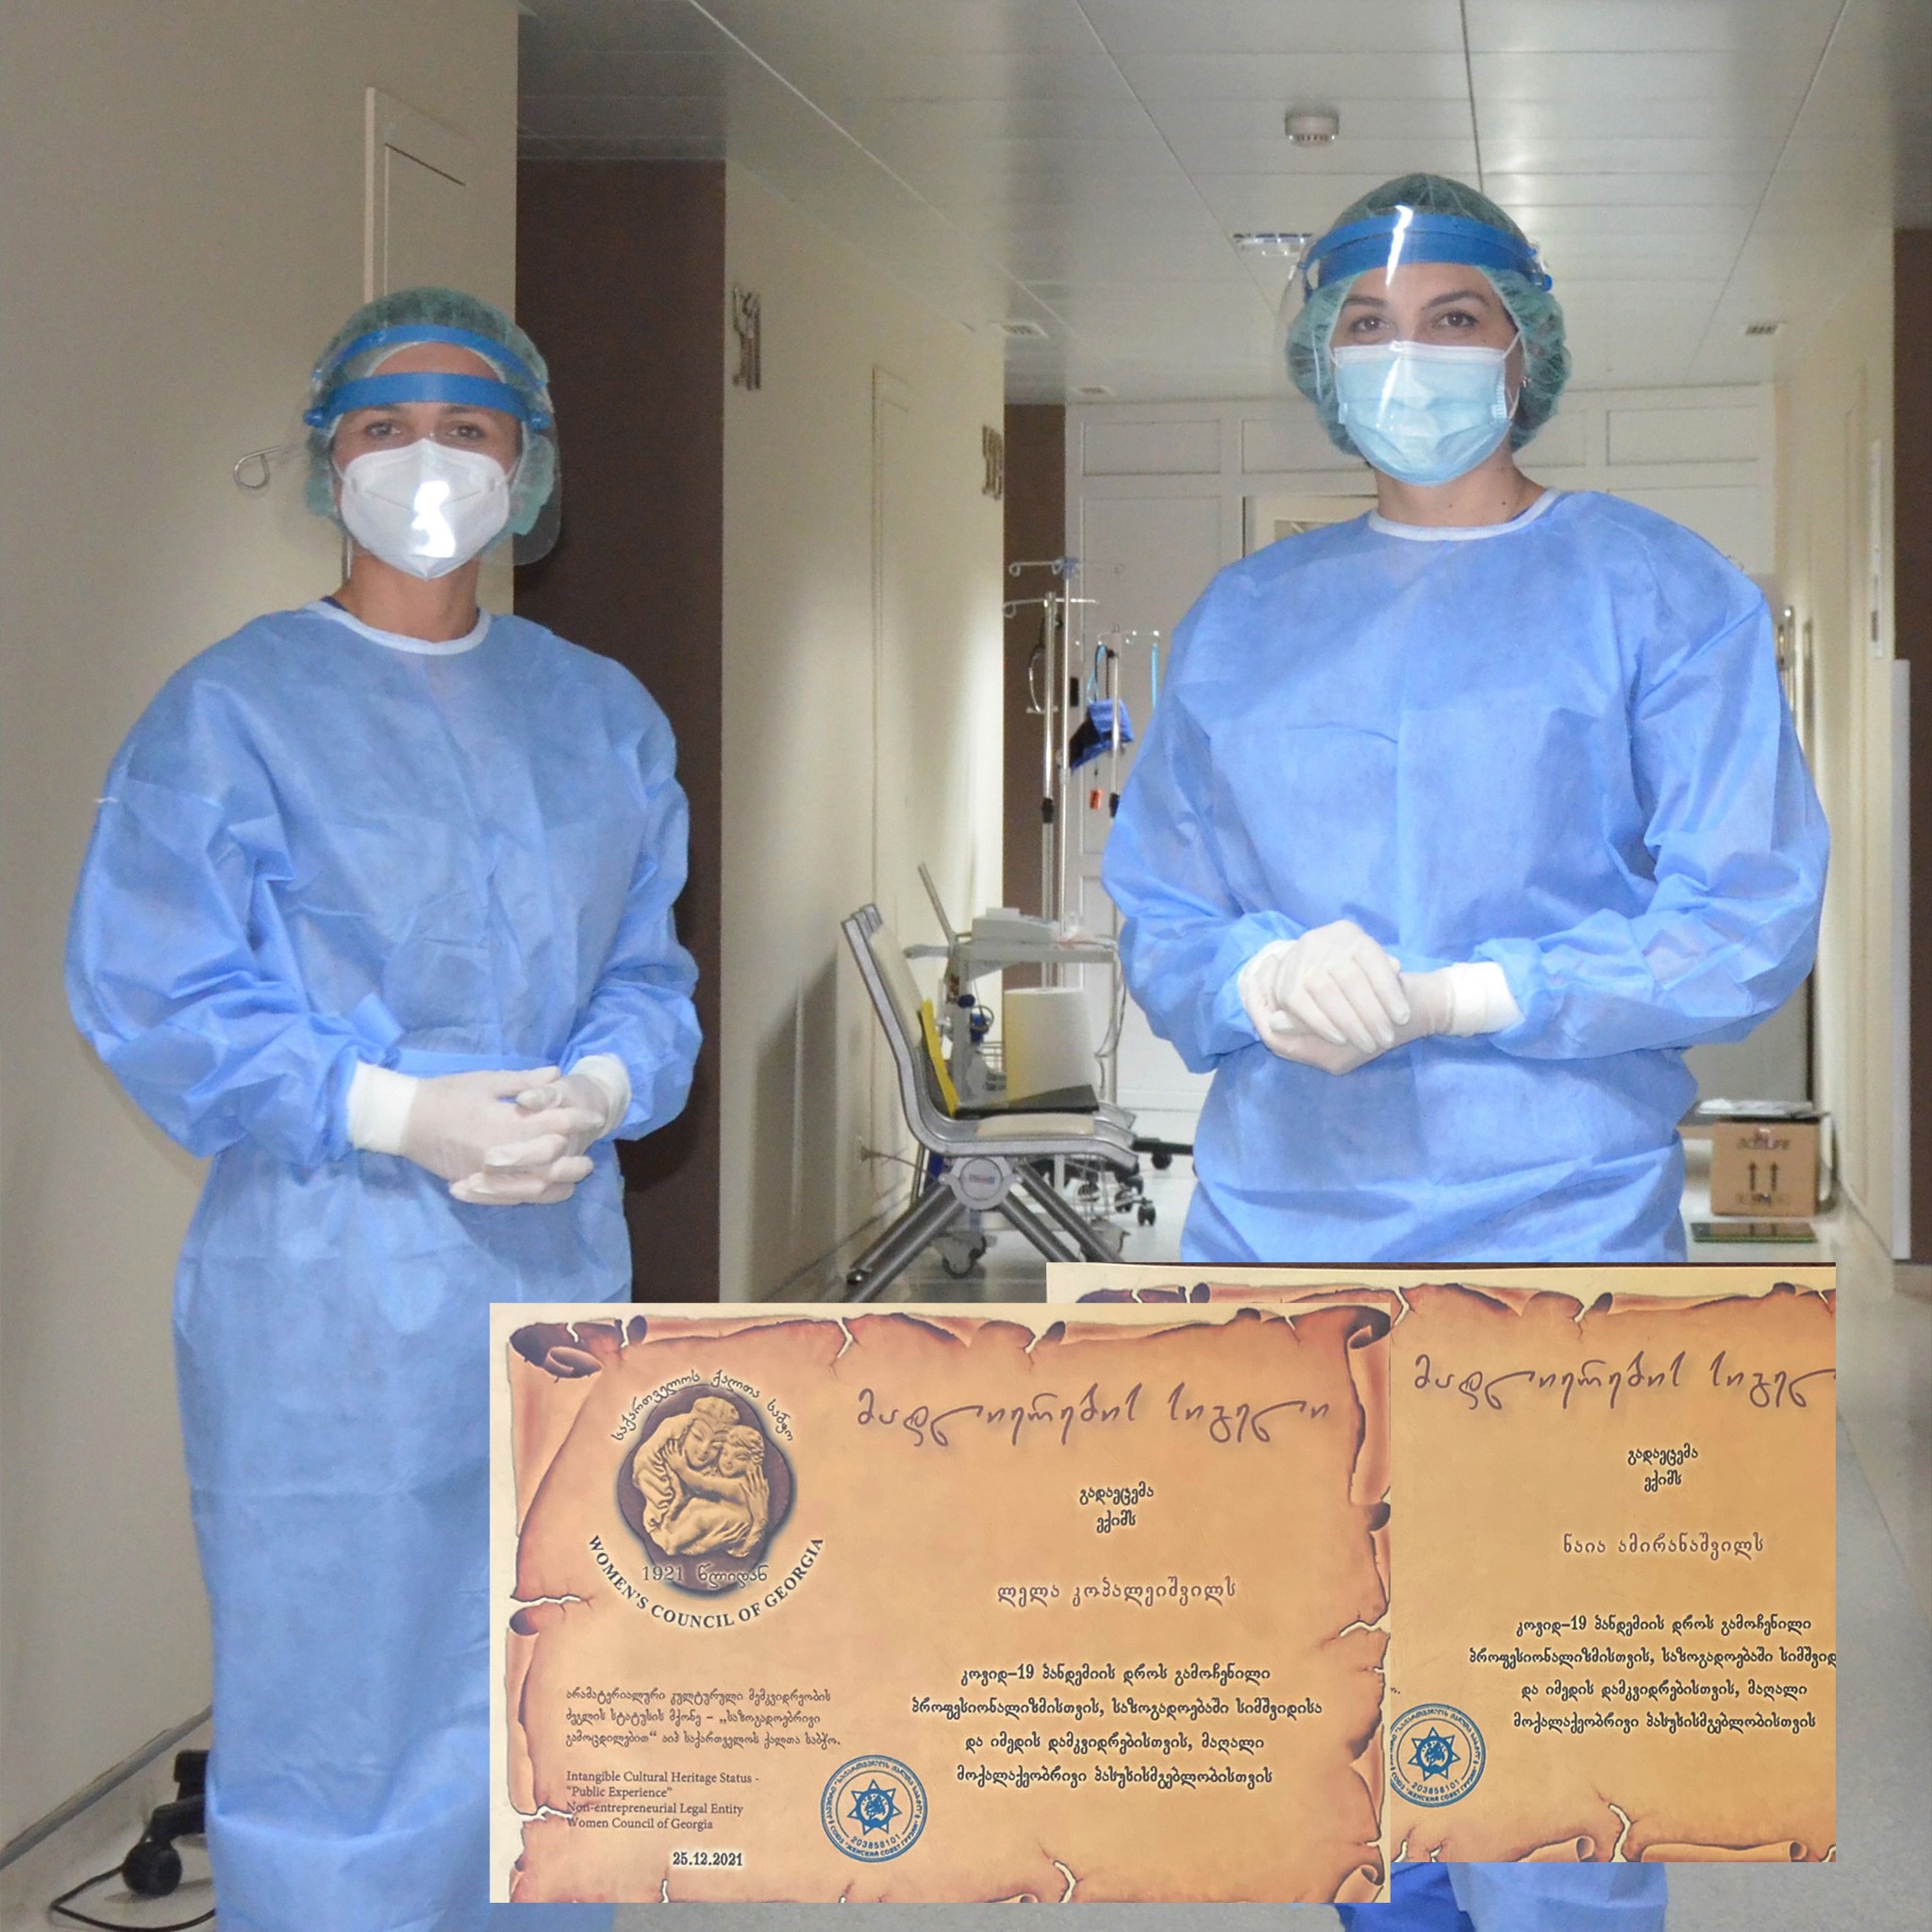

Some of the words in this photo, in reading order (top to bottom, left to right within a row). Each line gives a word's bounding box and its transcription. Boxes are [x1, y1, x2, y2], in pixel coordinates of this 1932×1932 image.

[1627, 1442, 1699, 1466] გადაეცემა
[1644, 1469, 1682, 1492] ექიმს
[1079, 1481, 1155, 1506] გადაეცემა
[1096, 1509, 1137, 1533] ექიმს
[1563, 1533, 1607, 1555] ნაია
[1618, 1531, 1763, 1561] ამირანაშვილს
[641, 1565, 683, 1582] 1921
[651, 1604, 735, 1628] COUNCIL
[738, 1602, 761, 1622] OF
[764, 1538, 824, 1608] GEORGIA
[997, 1584, 1060, 1607] ლელა
[1594, 1614, 1665, 1638] პანდემიის
[1672, 1614, 1714, 1637] დროს
[1721, 1614, 1812, 1637] გამოჩენილი
[1661, 1646, 1774, 1670] საზოგადოებაში
[1041, 1663, 1116, 1687] პანდემიის
[1123, 1663, 1168, 1686] დროს
[1174, 1663, 1271, 1687] გამოჩენილი
[1522, 1685, 1540, 1702] და
[1546, 1679, 1594, 1702] იმედის
[1747, 1679, 1808, 1702] მაღალი
[1111, 1697, 1229, 1721] საზოგადოებაში
[1236, 1697, 1323, 1721] სიმშვიდისა
[965, 1736, 984, 1754] და
[990, 1731, 1041, 1755] იმედის
[1201, 1732, 1265, 1755] მაღალი
[567, 1771, 621, 1784] Intangible
[624, 1771, 668, 1783] Cultural
[672, 1772, 717, 1786] Heritage
[720, 1773, 752, 1783] Status
[567, 1802, 677, 1814] Non-entrepreneurial
[680, 1803, 708, 1815] Legal
[710, 1804, 743, 1817] Entity
[567, 1816, 609, 1828] Women
[611, 1817, 654, 1829] Council
[657, 1818, 670, 1828] of
[671, 1817, 714, 1832] Georgia
[673, 1851, 742, 1867] 25.12.2021
